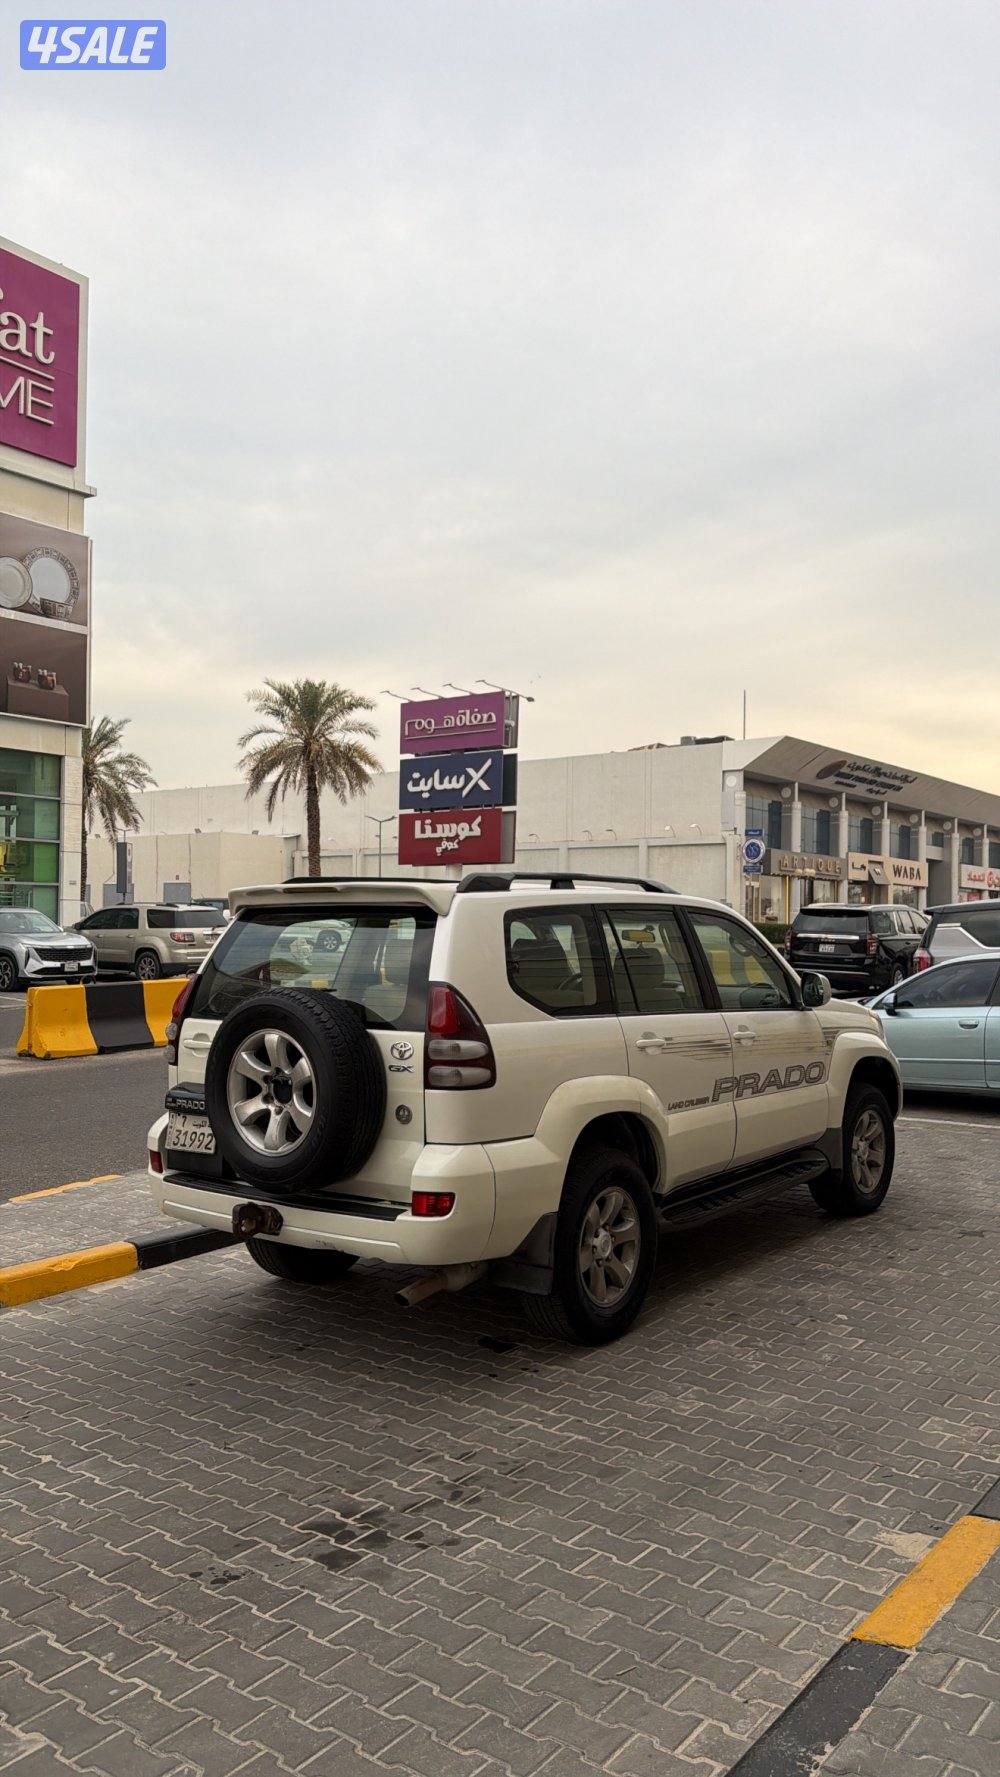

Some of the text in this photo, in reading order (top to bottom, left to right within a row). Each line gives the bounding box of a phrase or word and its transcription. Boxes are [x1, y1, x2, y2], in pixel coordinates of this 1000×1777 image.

[0, 287, 55, 365] at
[414, 815, 482, 841] كوستا
[435, 838, 460, 857] كوفي
[892, 864, 922, 881] WABA
[388, 1064, 415, 1074] GX
[711, 1061, 826, 1103] PRADO
[176, 1099, 205, 1110] PRADO
[172, 1129, 214, 1151] 31992
